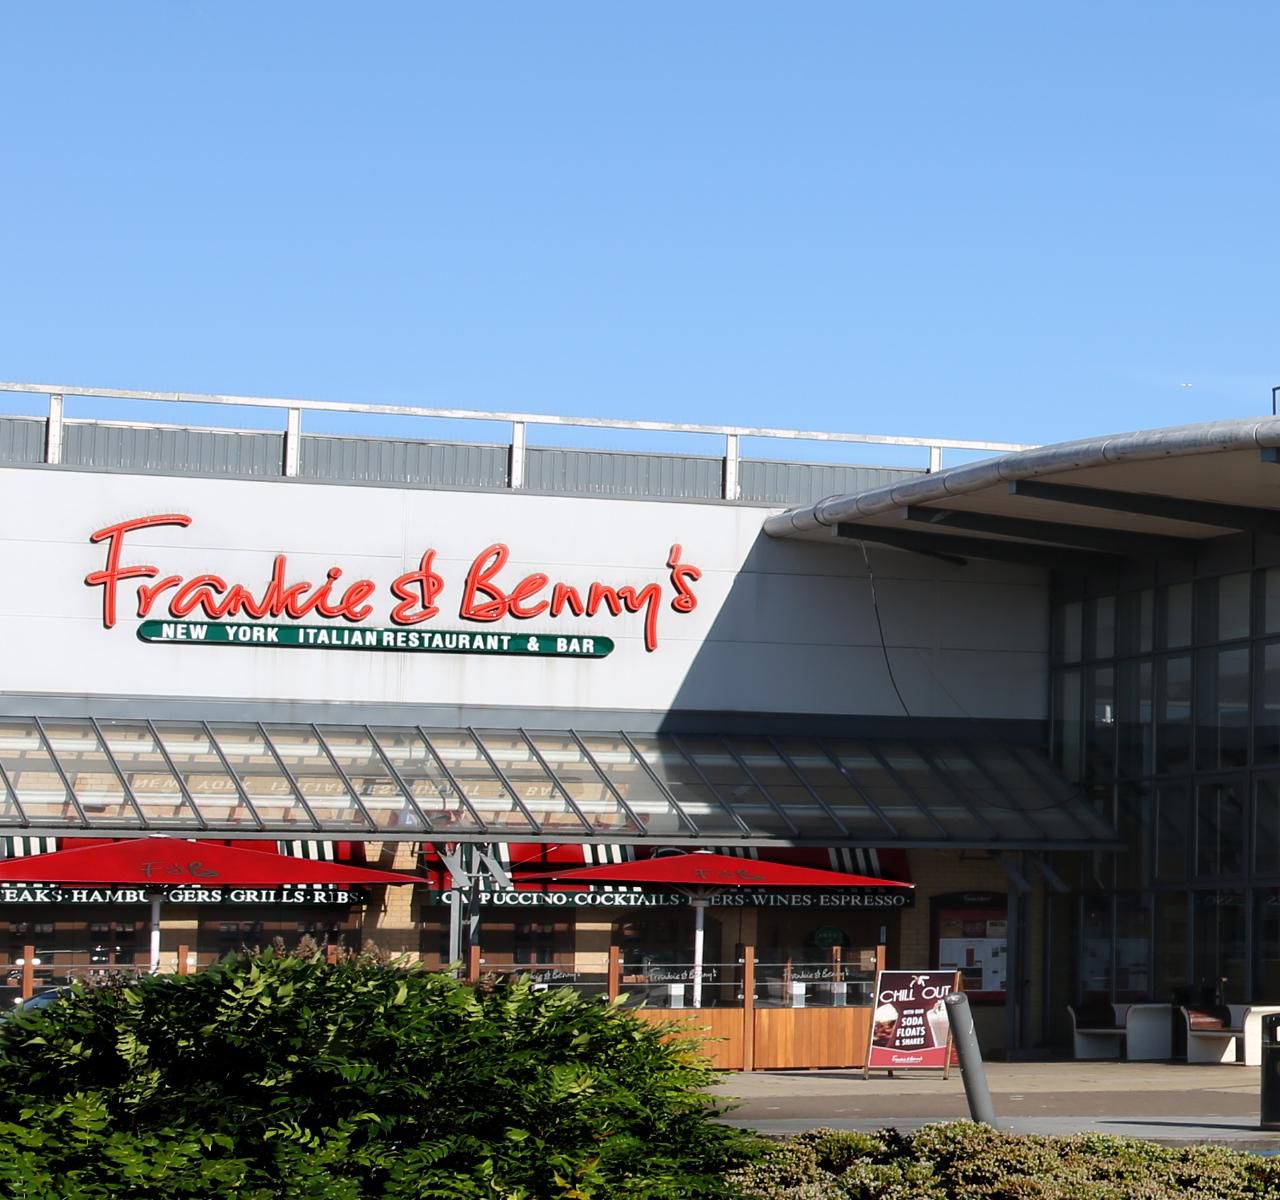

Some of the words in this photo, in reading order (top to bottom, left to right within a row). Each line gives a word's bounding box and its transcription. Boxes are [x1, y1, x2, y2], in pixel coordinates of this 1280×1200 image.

[84, 513, 376, 629] Frankie
[390, 547, 445, 627] &
[458, 542, 703, 653] Benny's
[162, 624, 208, 640] NEW
[226, 625, 279, 642] YORK
[299, 628, 378, 646] ITALIAN
[382, 631, 512, 651] RESTAURANT
[527, 636, 540, 652] &
[556, 637, 595, 654] BAR
[0, 889, 62, 903] EAKS
[72, 889, 222, 904] HAMBUGERS
[231, 889, 304, 904] GRILLS
[314, 889, 358, 904] RIBS
[441, 891, 568, 906] CAPUCCINO
[575, 892, 679, 906] COCKTAILS
[688, 893, 744, 907] ERS
[751, 893, 812, 907] WINES
[818, 893, 905, 907] ESPRESSO
[880, 988, 916, 1003] CHILL
[922, 985, 952, 999] OUT
[901, 1016, 924, 1026] SODA
[896, 1026, 926, 1037] FLOATS
